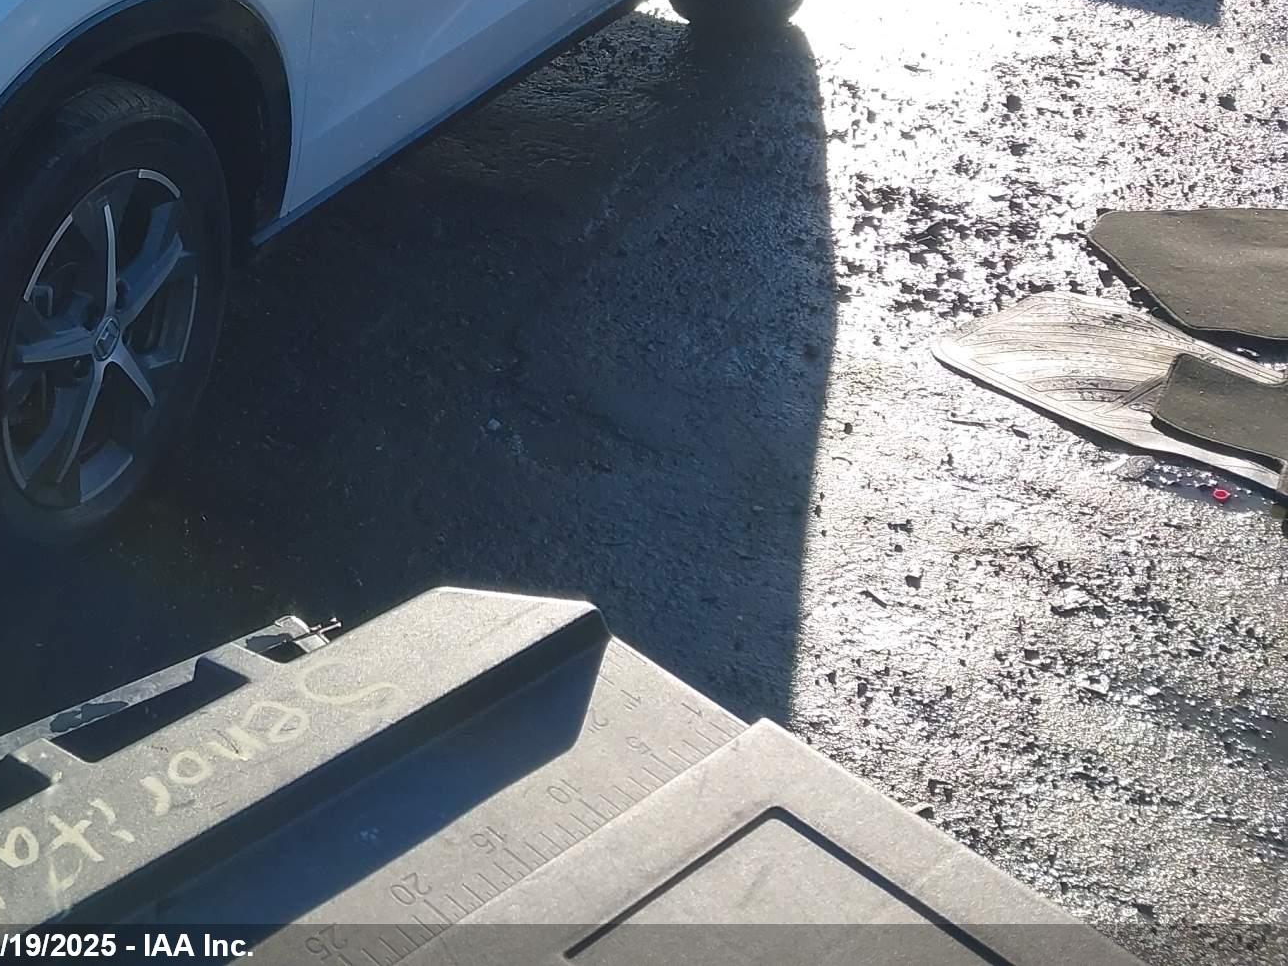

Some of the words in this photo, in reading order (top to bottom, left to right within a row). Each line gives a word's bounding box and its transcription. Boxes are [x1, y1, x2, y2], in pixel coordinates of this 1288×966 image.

[469, 825, 508, 856] 15
[390, 872, 433, 907] 20
[304, 922, 349, 962] 25
